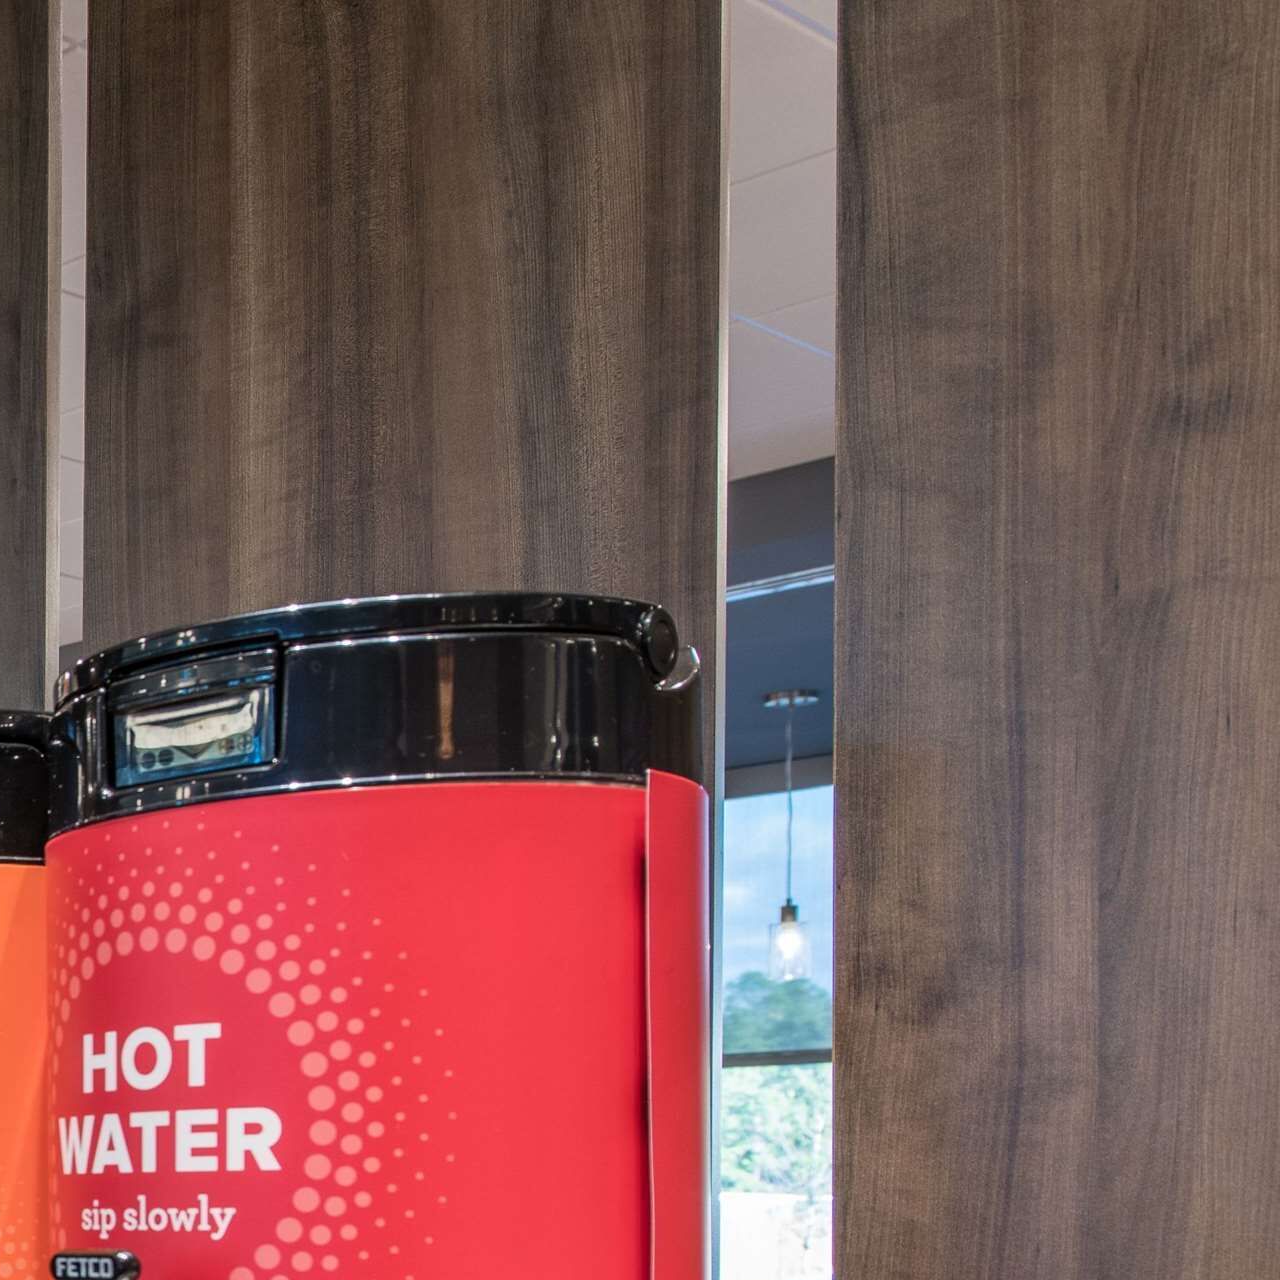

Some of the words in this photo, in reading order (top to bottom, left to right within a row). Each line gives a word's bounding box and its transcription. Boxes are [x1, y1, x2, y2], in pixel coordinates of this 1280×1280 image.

[82, 1022, 222, 1094] HOT
[58, 1107, 283, 1175] WATER
[81, 1200, 117, 1239] sip
[122, 1193, 237, 1241] slowly
[55, 1255, 114, 1279] FETCO
